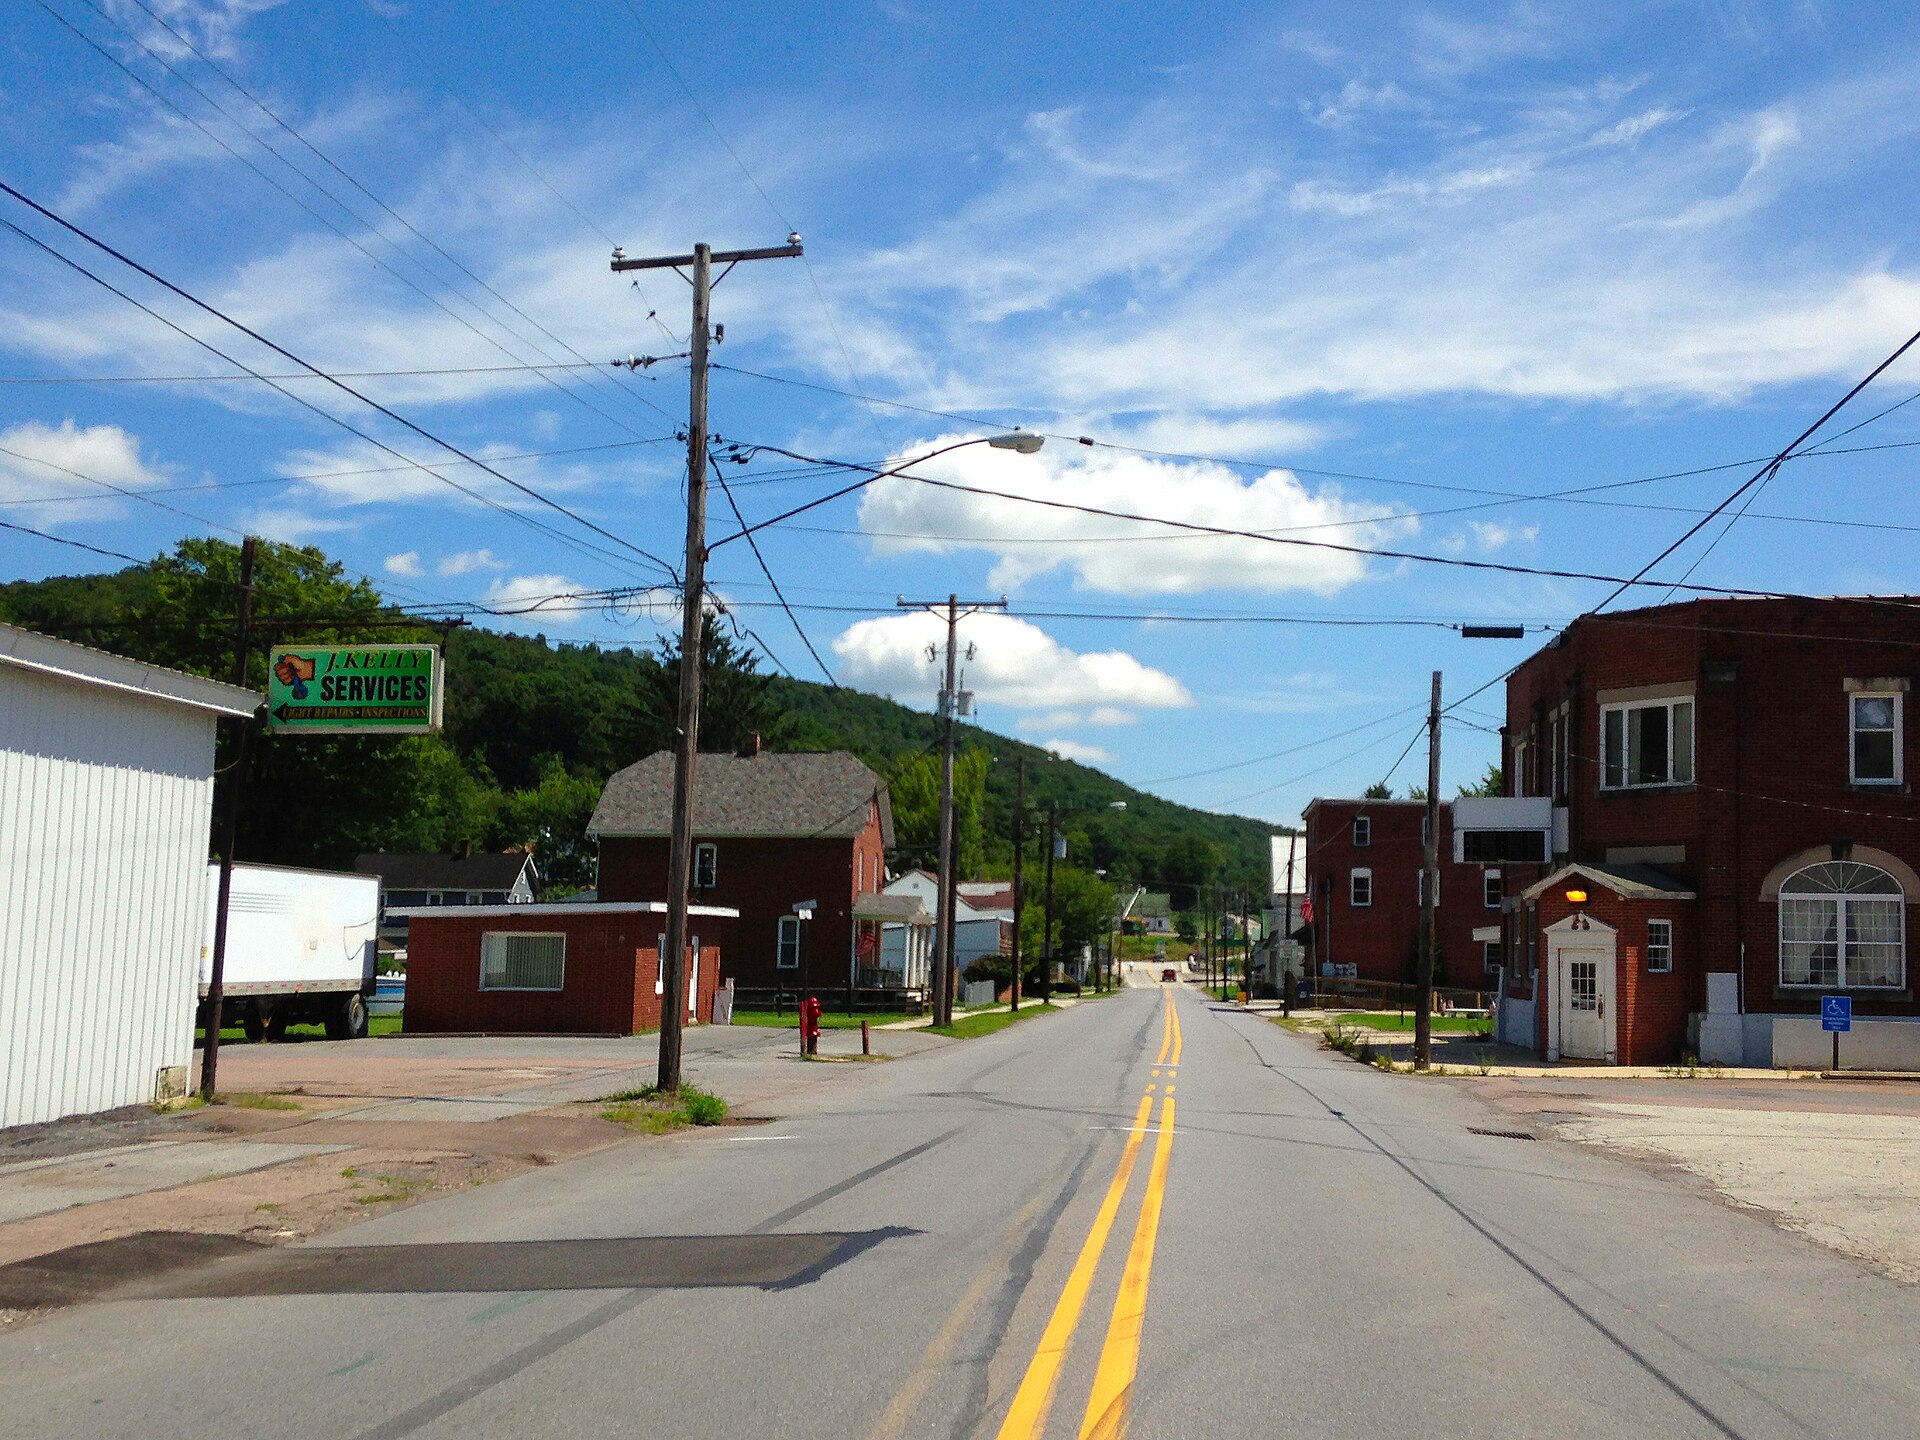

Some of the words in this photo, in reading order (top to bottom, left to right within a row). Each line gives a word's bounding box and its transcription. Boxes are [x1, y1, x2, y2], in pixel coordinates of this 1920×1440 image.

[320, 675, 428, 701] SERVICES
[283, 706, 311, 718] LIGHT
[314, 706, 354, 718] REPAIRS
[361, 706, 426, 718] INSPECTIONS
